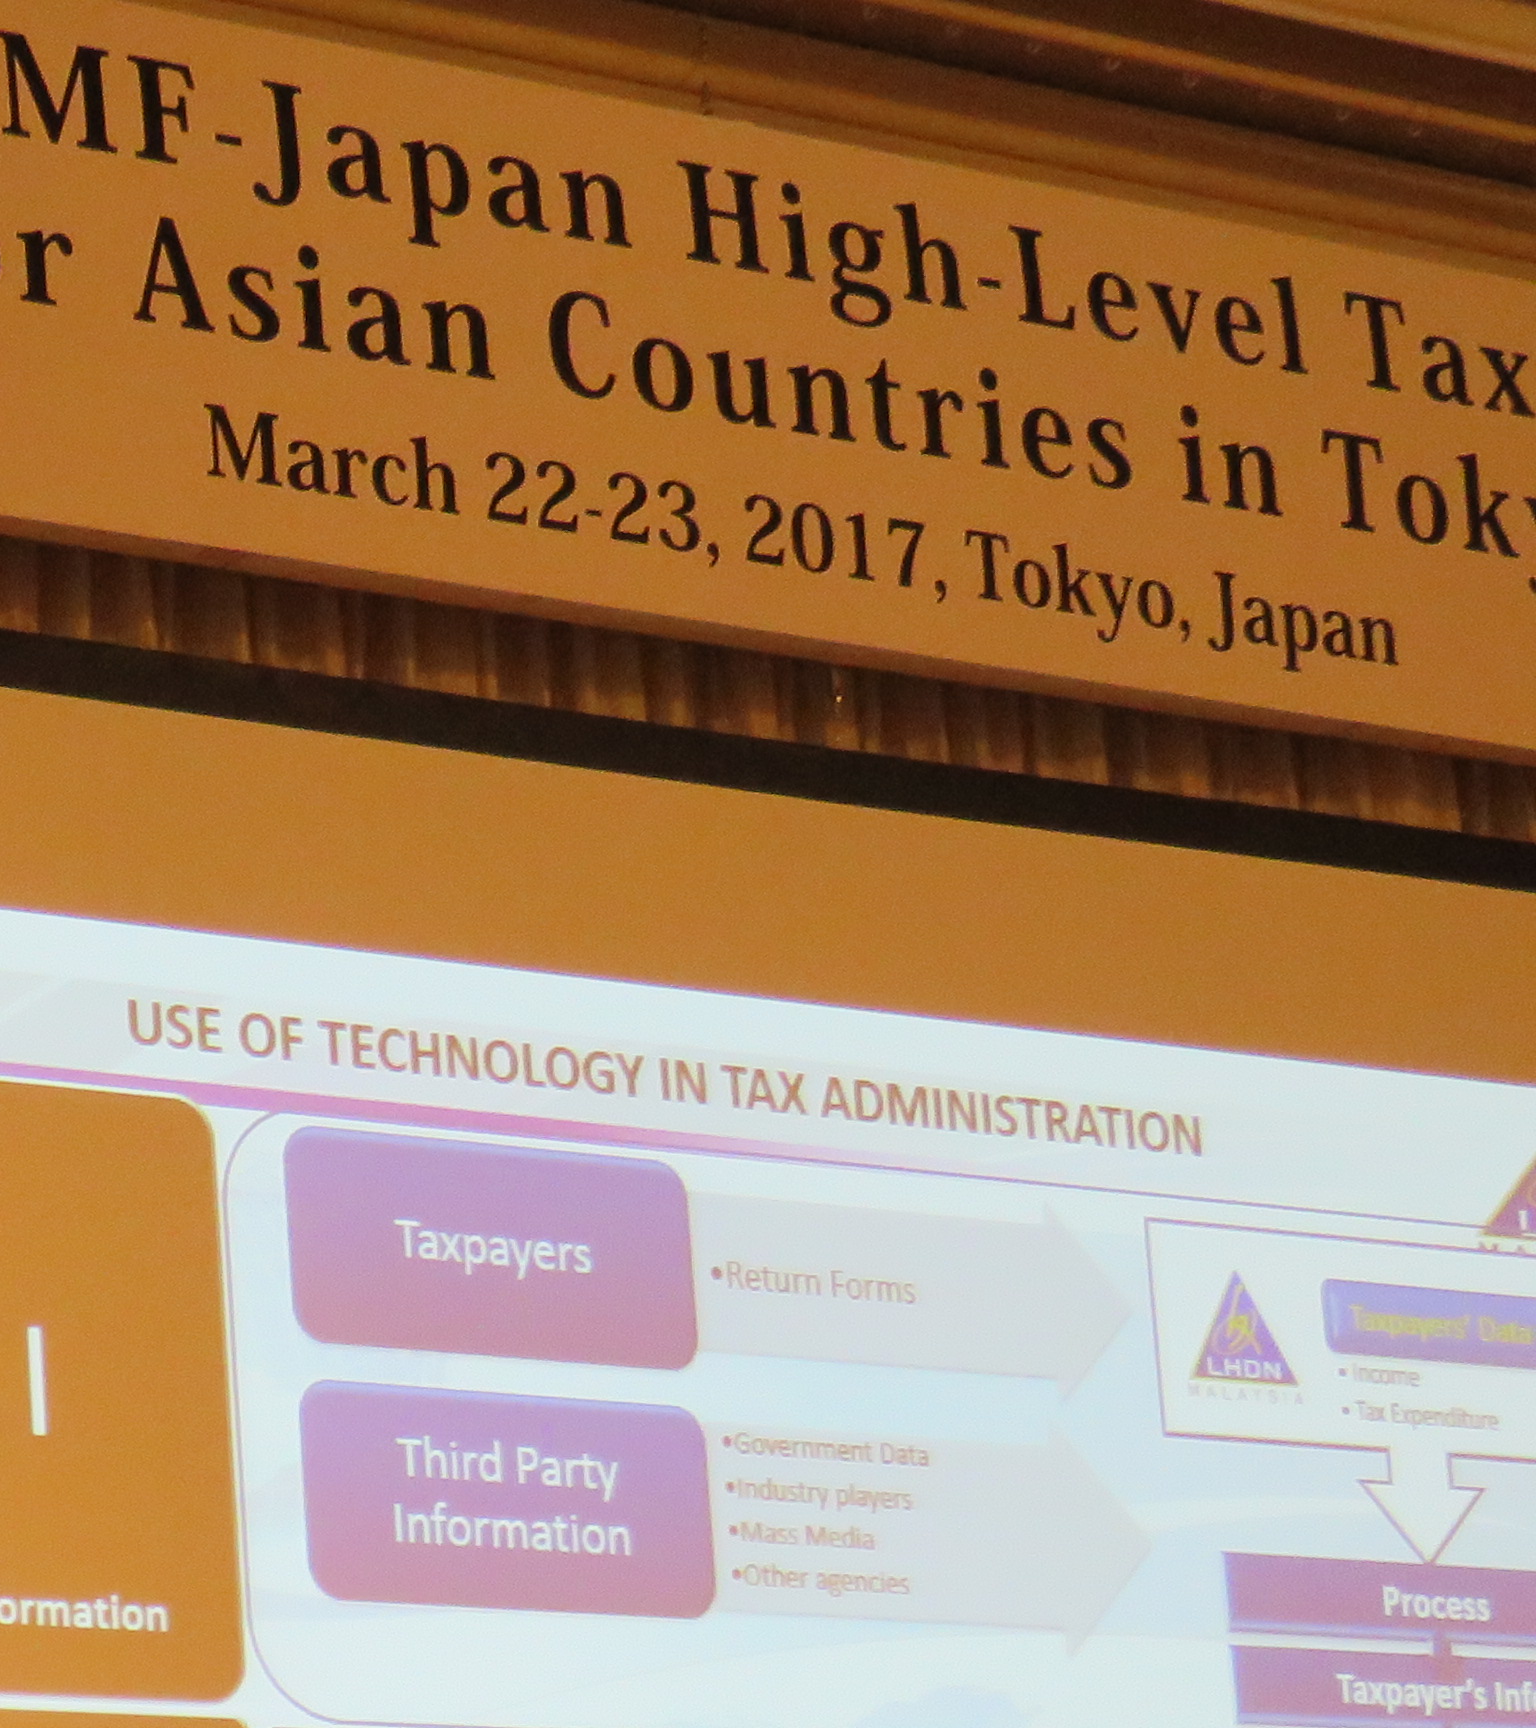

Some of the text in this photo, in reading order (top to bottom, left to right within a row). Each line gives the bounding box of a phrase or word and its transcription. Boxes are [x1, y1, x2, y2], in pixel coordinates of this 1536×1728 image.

[676, 158, 1310, 375] High-Level
[1344, 290, 1535, 419] Tax
[134, 216, 496, 381] Asian
[548, 289, 1133, 492] Countries
[1179, 405, 1283, 517] in
[1321, 428, 1536, 595] Tok
[204, 402, 1400, 673] March 22-23, 2017, Tokyo, Japan
[127, 999, 1204, 1157] USE OF TECHNOLOGY IN TAX ADMINISTRATION
[393, 1218, 593, 1279] Taxpayers
[726, 1260, 918, 1306] Return Forms
[27, 1325, 48, 1437] I
[1206, 1356, 1283, 1380] LHDN
[1352, 1364, 1420, 1387] Income
[1355, 1400, 1501, 1431] Tax Expenditure
[396, 1436, 619, 1501] Third Party
[734, 1432, 930, 1467] Government Data
[737, 1477, 914, 1513] Industry players
[391, 1503, 633, 1558] Information
[740, 1521, 876, 1550] Mass Media
[744, 1563, 911, 1597] Other agencies
[1381, 1584, 1493, 1622] Process
[1335, 1672, 1536, 1717] Taxpayer's Inf
